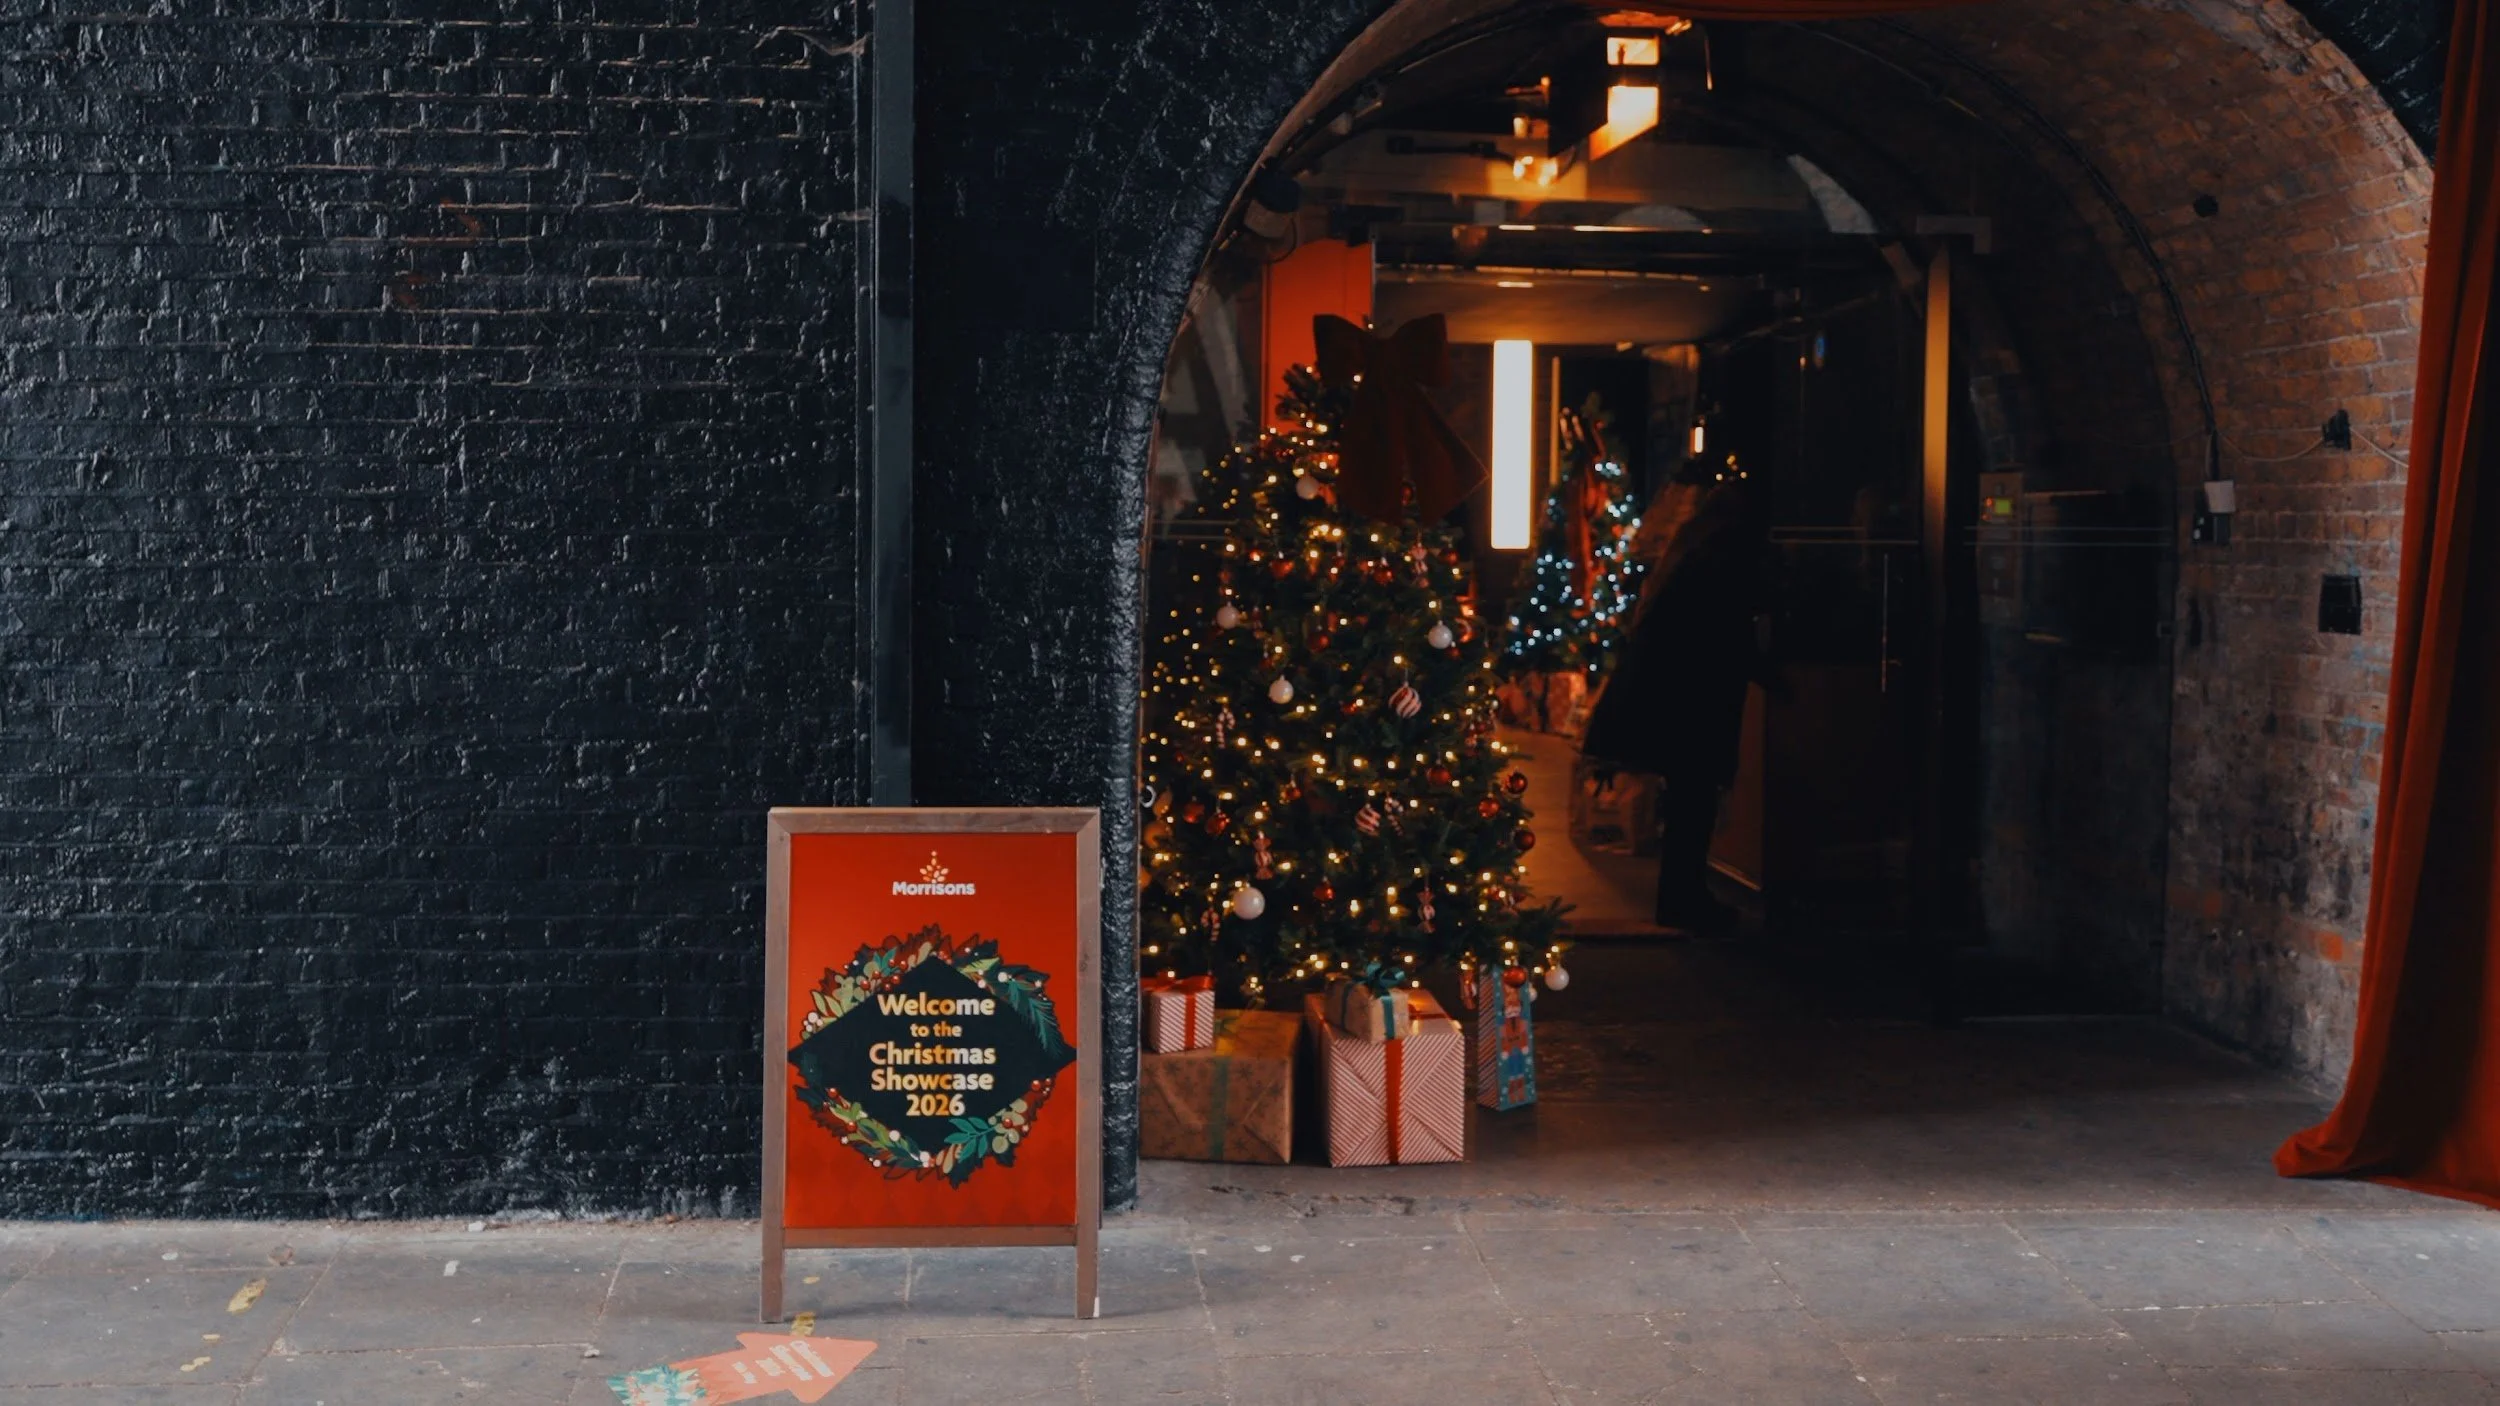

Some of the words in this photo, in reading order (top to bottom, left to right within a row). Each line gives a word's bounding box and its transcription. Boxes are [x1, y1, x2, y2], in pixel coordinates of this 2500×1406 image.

[893, 881, 976, 895] Morrisons
[877, 991, 995, 1015] Welcome
[910, 1023, 929, 1037] to
[932, 1021, 962, 1037] the
[869, 1041, 996, 1065] Christmas
[871, 1066, 994, 1090] Showcase
[906, 1094, 965, 1117] 2026
